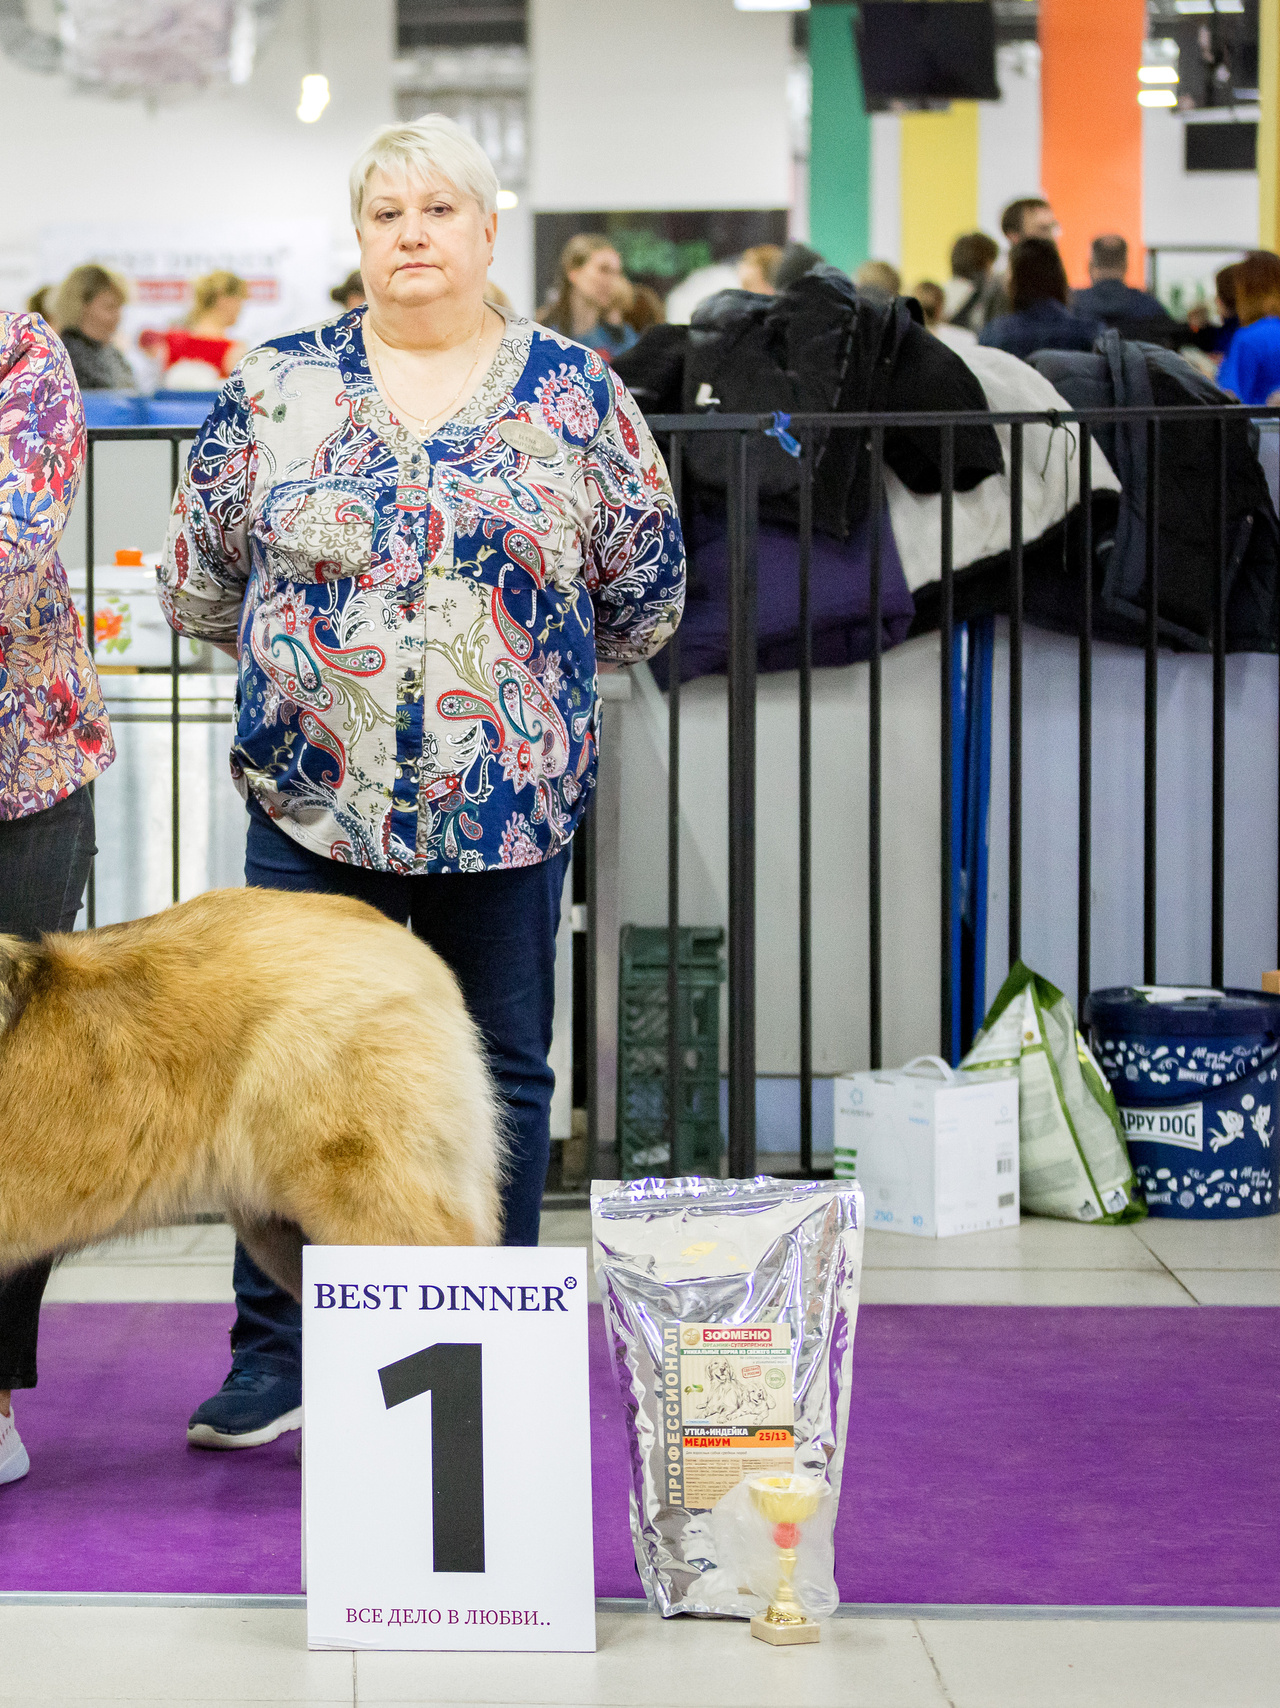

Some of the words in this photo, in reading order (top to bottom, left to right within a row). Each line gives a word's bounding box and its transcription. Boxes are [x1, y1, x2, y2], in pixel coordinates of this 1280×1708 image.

[1120, 1109, 1156, 1131] APPY
[1159, 1113, 1196, 1138] DOG
[314, 1283, 408, 1310] BEST
[419, 1285, 568, 1311] DINNER
[704, 1330, 770, 1341] ЗООМЕНЮ
[664, 1328, 682, 1505] ПРОФЕССИОНАЛ
[684, 1438, 731, 1447] МЕДИУМ
[759, 1432, 787, 1441] 25/13
[377, 1342, 485, 1573] 1
[346, 1608, 383, 1623] ВСЕ
[387, 1609, 442, 1626] ДЕЛО
[448, 1610, 459, 1624] В
